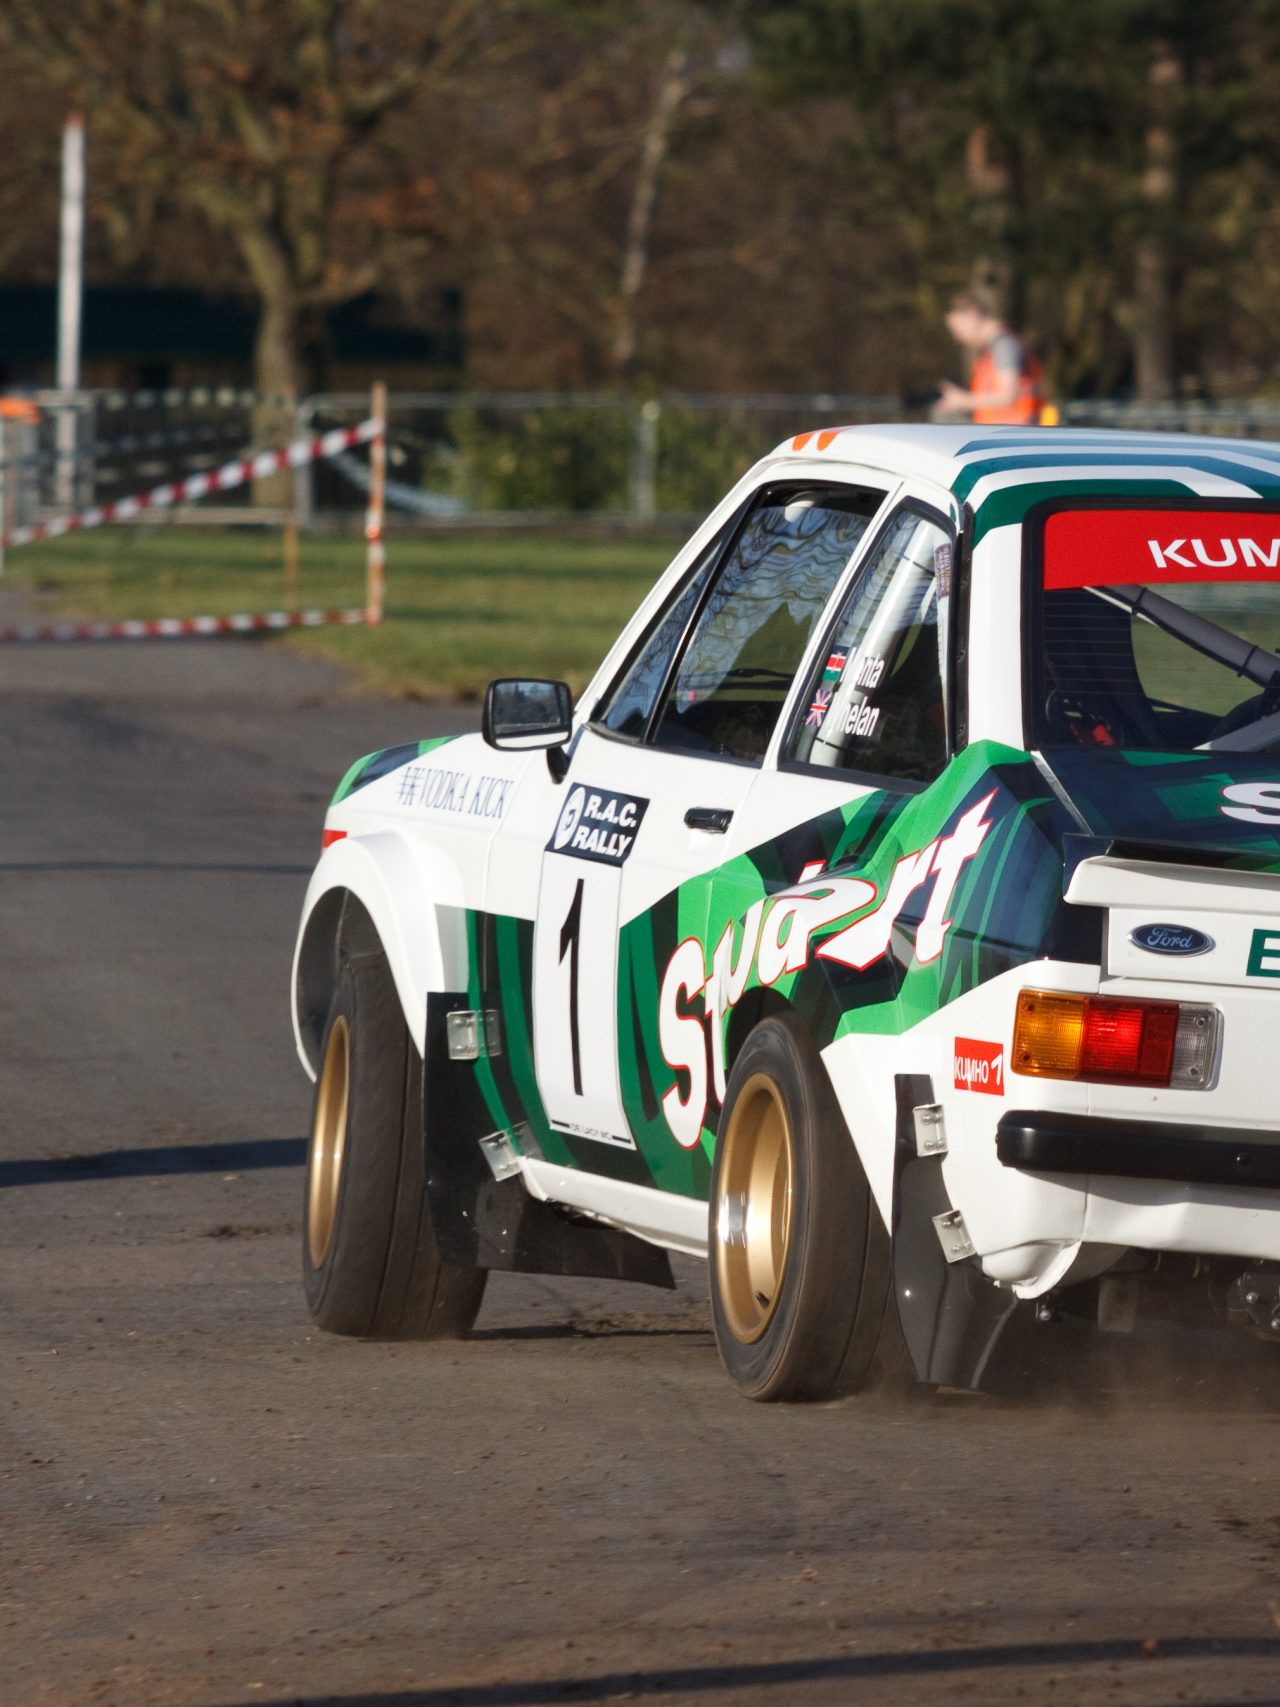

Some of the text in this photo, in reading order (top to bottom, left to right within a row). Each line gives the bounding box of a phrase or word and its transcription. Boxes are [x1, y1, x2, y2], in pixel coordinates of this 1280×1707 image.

[468, 776, 514, 819] KICK
[583, 793, 638, 828] R.A.C.
[571, 825, 633, 858] RALLY
[1146, 926, 1194, 950] Ford
[558, 877, 585, 1098] 1
[954, 1055, 989, 1085] KUMHO
